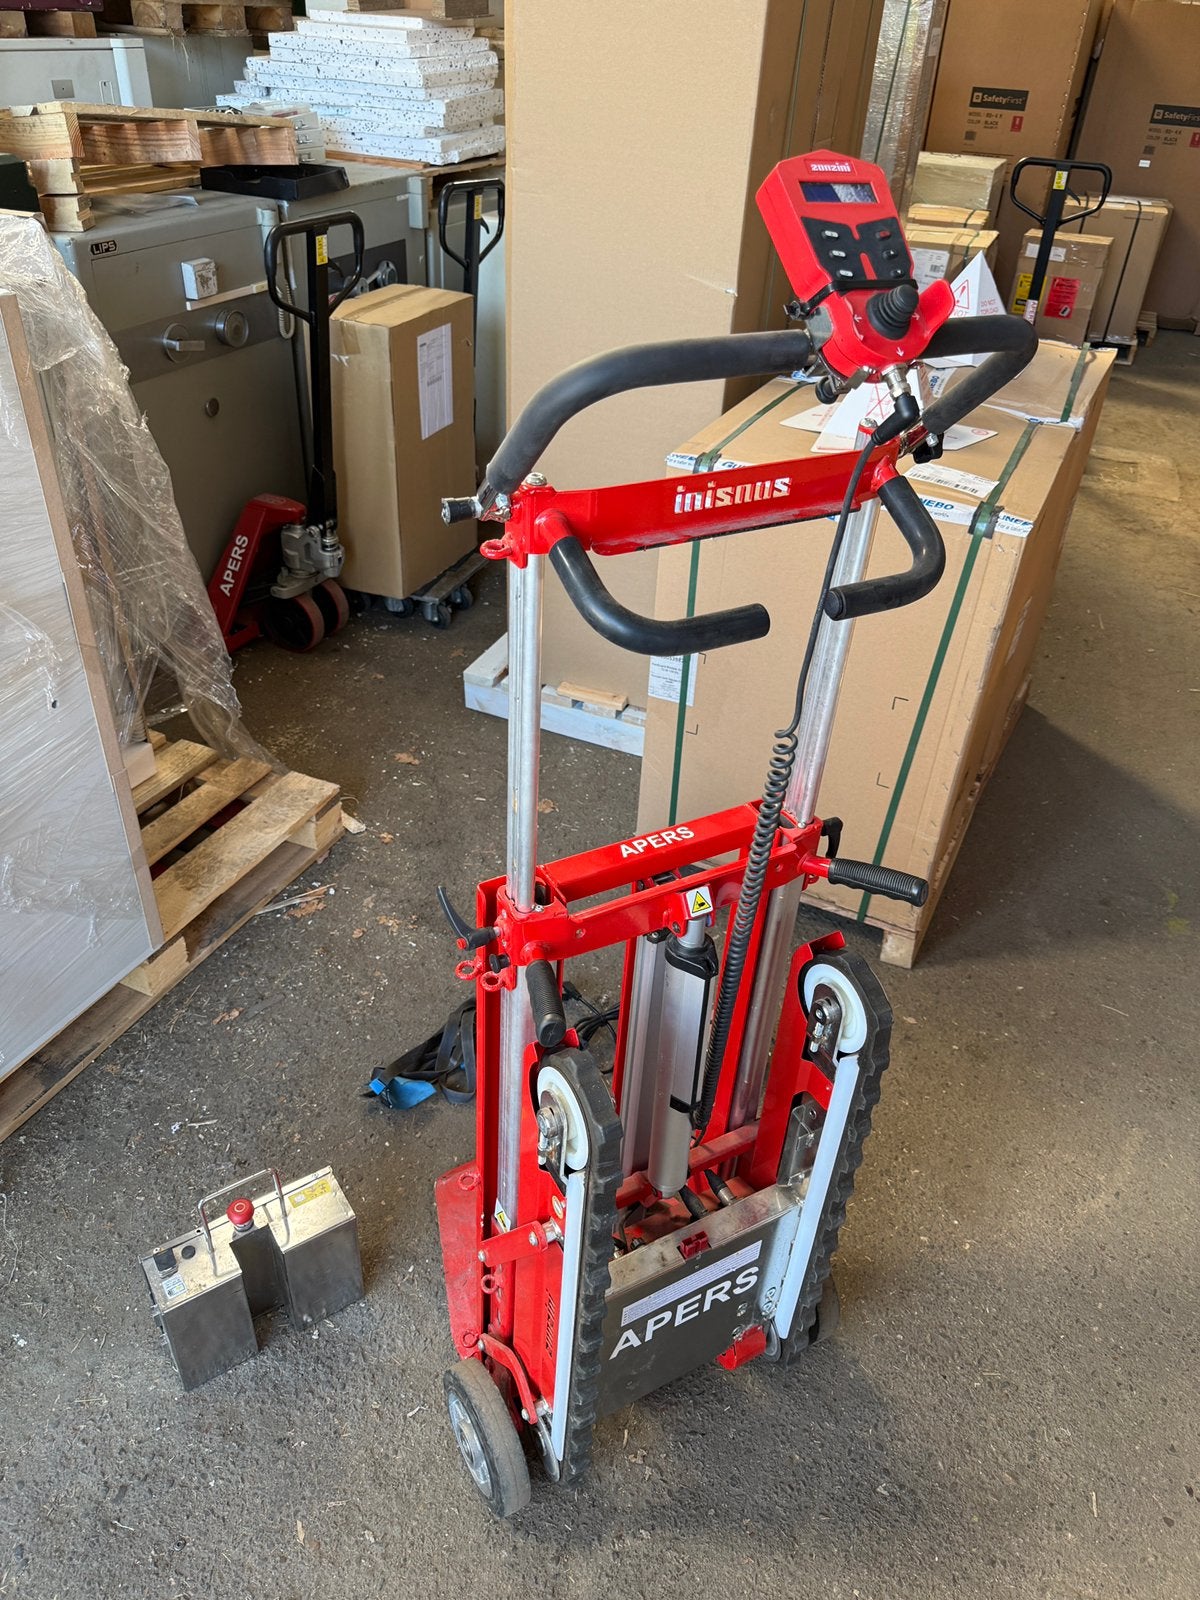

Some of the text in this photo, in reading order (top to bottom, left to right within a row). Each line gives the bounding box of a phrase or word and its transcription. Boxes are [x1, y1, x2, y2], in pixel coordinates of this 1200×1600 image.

[92, 241, 116, 254] LIPS
[219, 534, 249, 597] APERS
[620, 826, 695, 858] APERS
[609, 1266, 759, 1361] APERS
